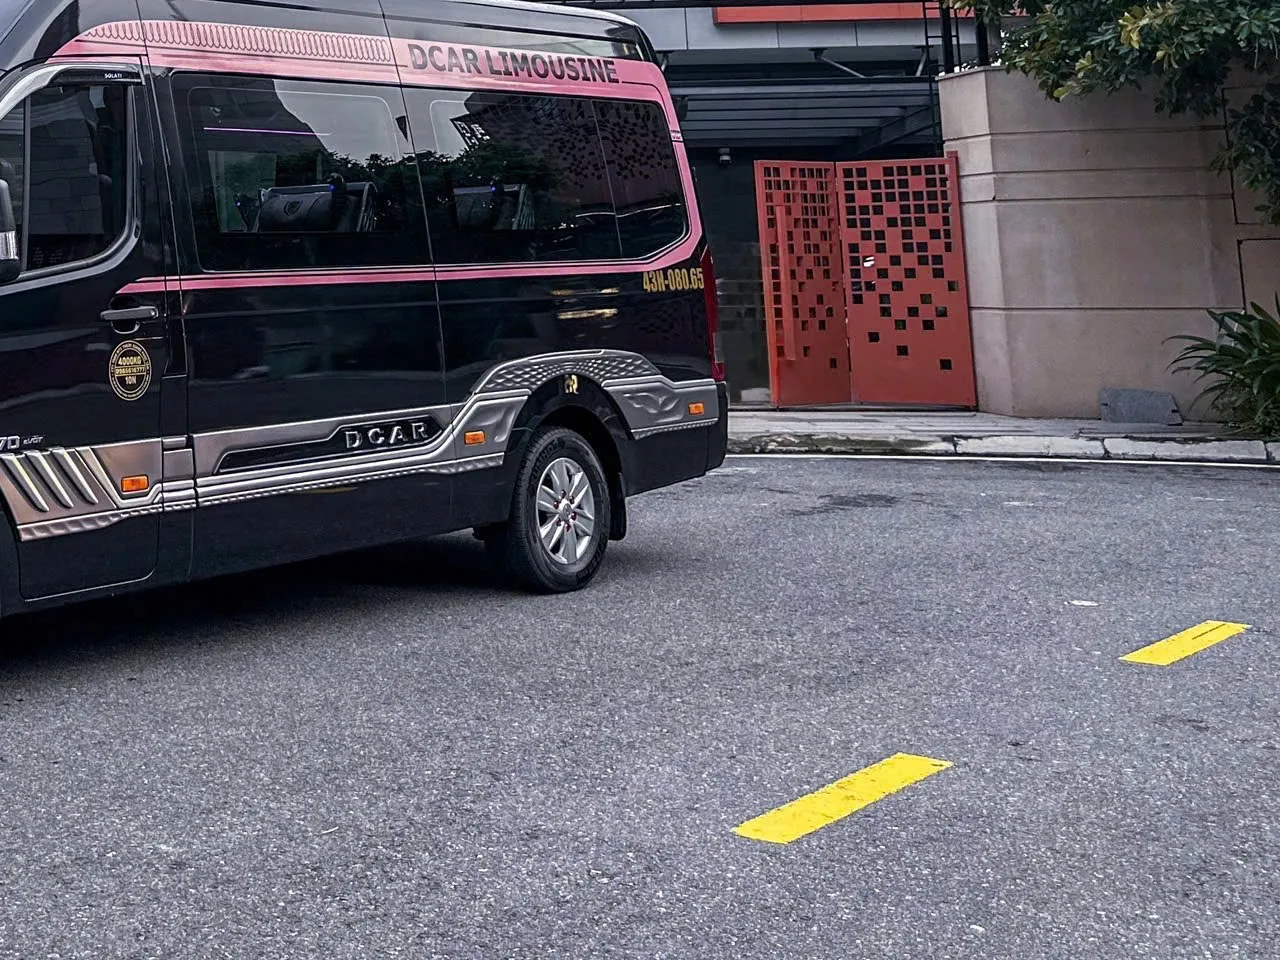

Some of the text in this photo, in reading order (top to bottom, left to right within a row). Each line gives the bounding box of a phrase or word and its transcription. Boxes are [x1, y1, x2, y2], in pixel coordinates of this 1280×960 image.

[407, 43, 620, 84] DCAR LIMOUSINE
[345, 422, 429, 449] DCAR
